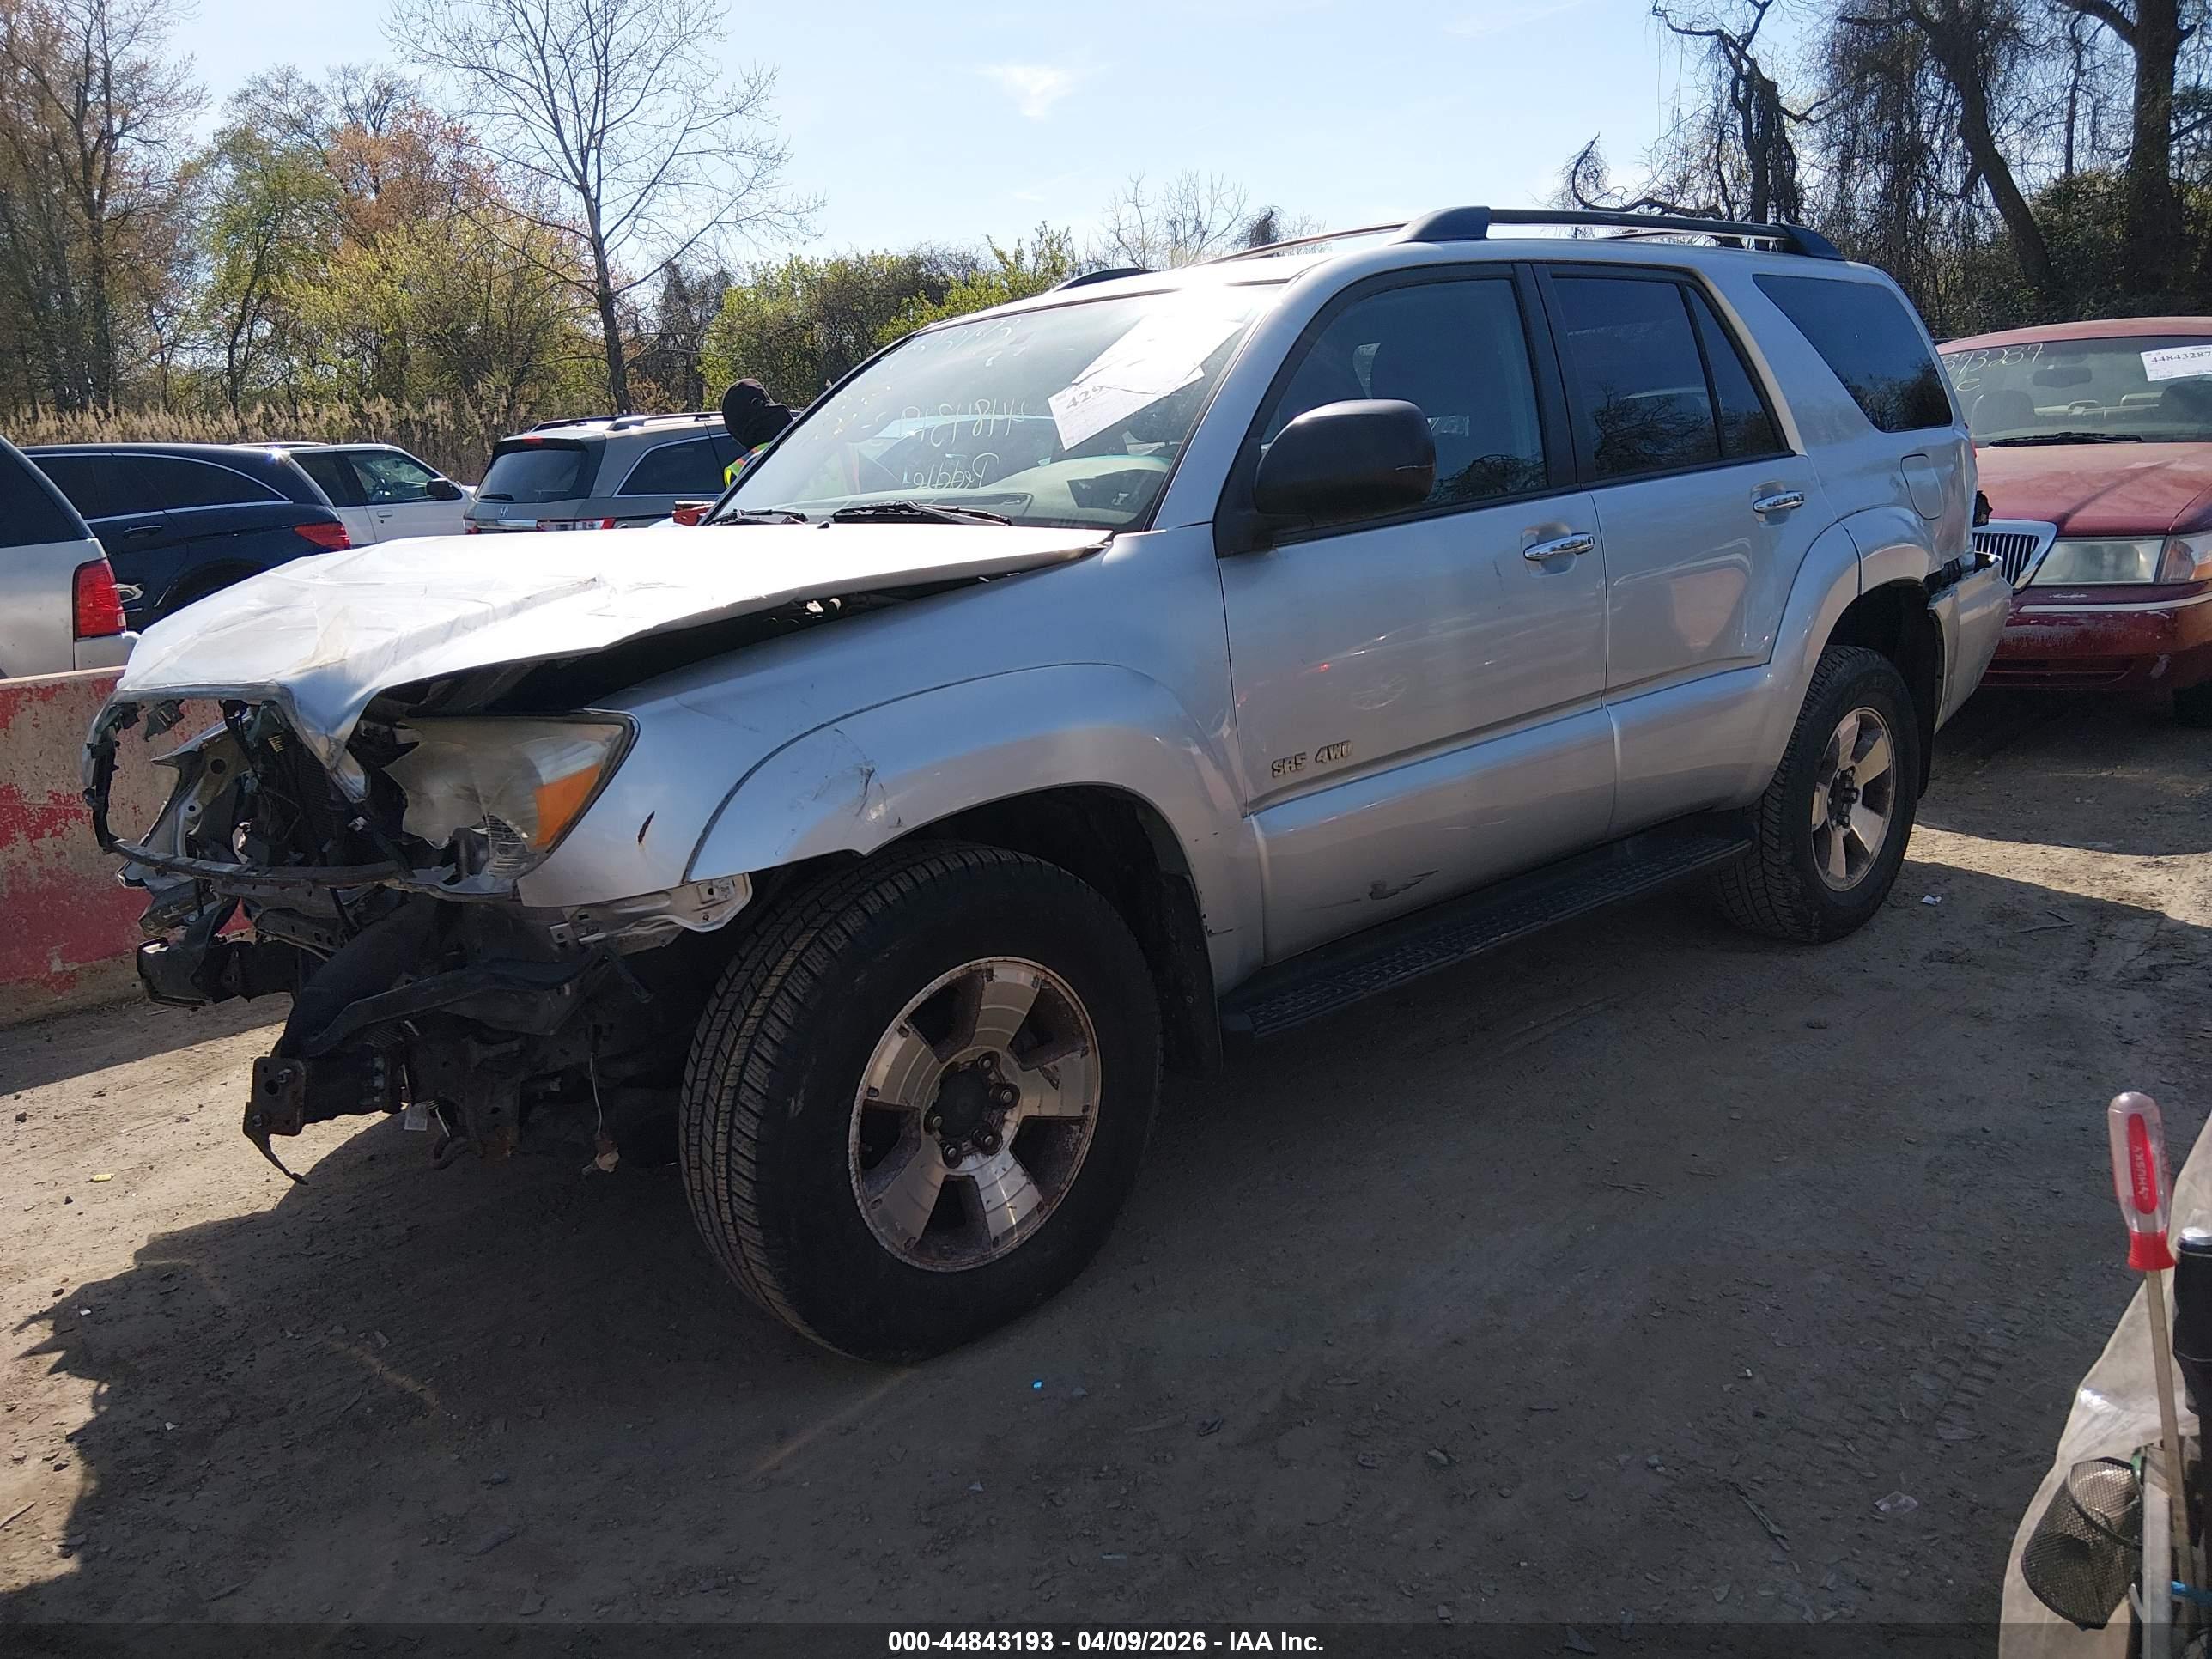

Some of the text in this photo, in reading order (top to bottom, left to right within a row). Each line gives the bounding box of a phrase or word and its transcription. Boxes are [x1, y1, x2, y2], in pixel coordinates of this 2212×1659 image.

[2151, 350, 2212, 363] 44843287
[1271, 740, 1352, 778] SR5 4WD
[2133, 1146, 2148, 1184] HUSKY
